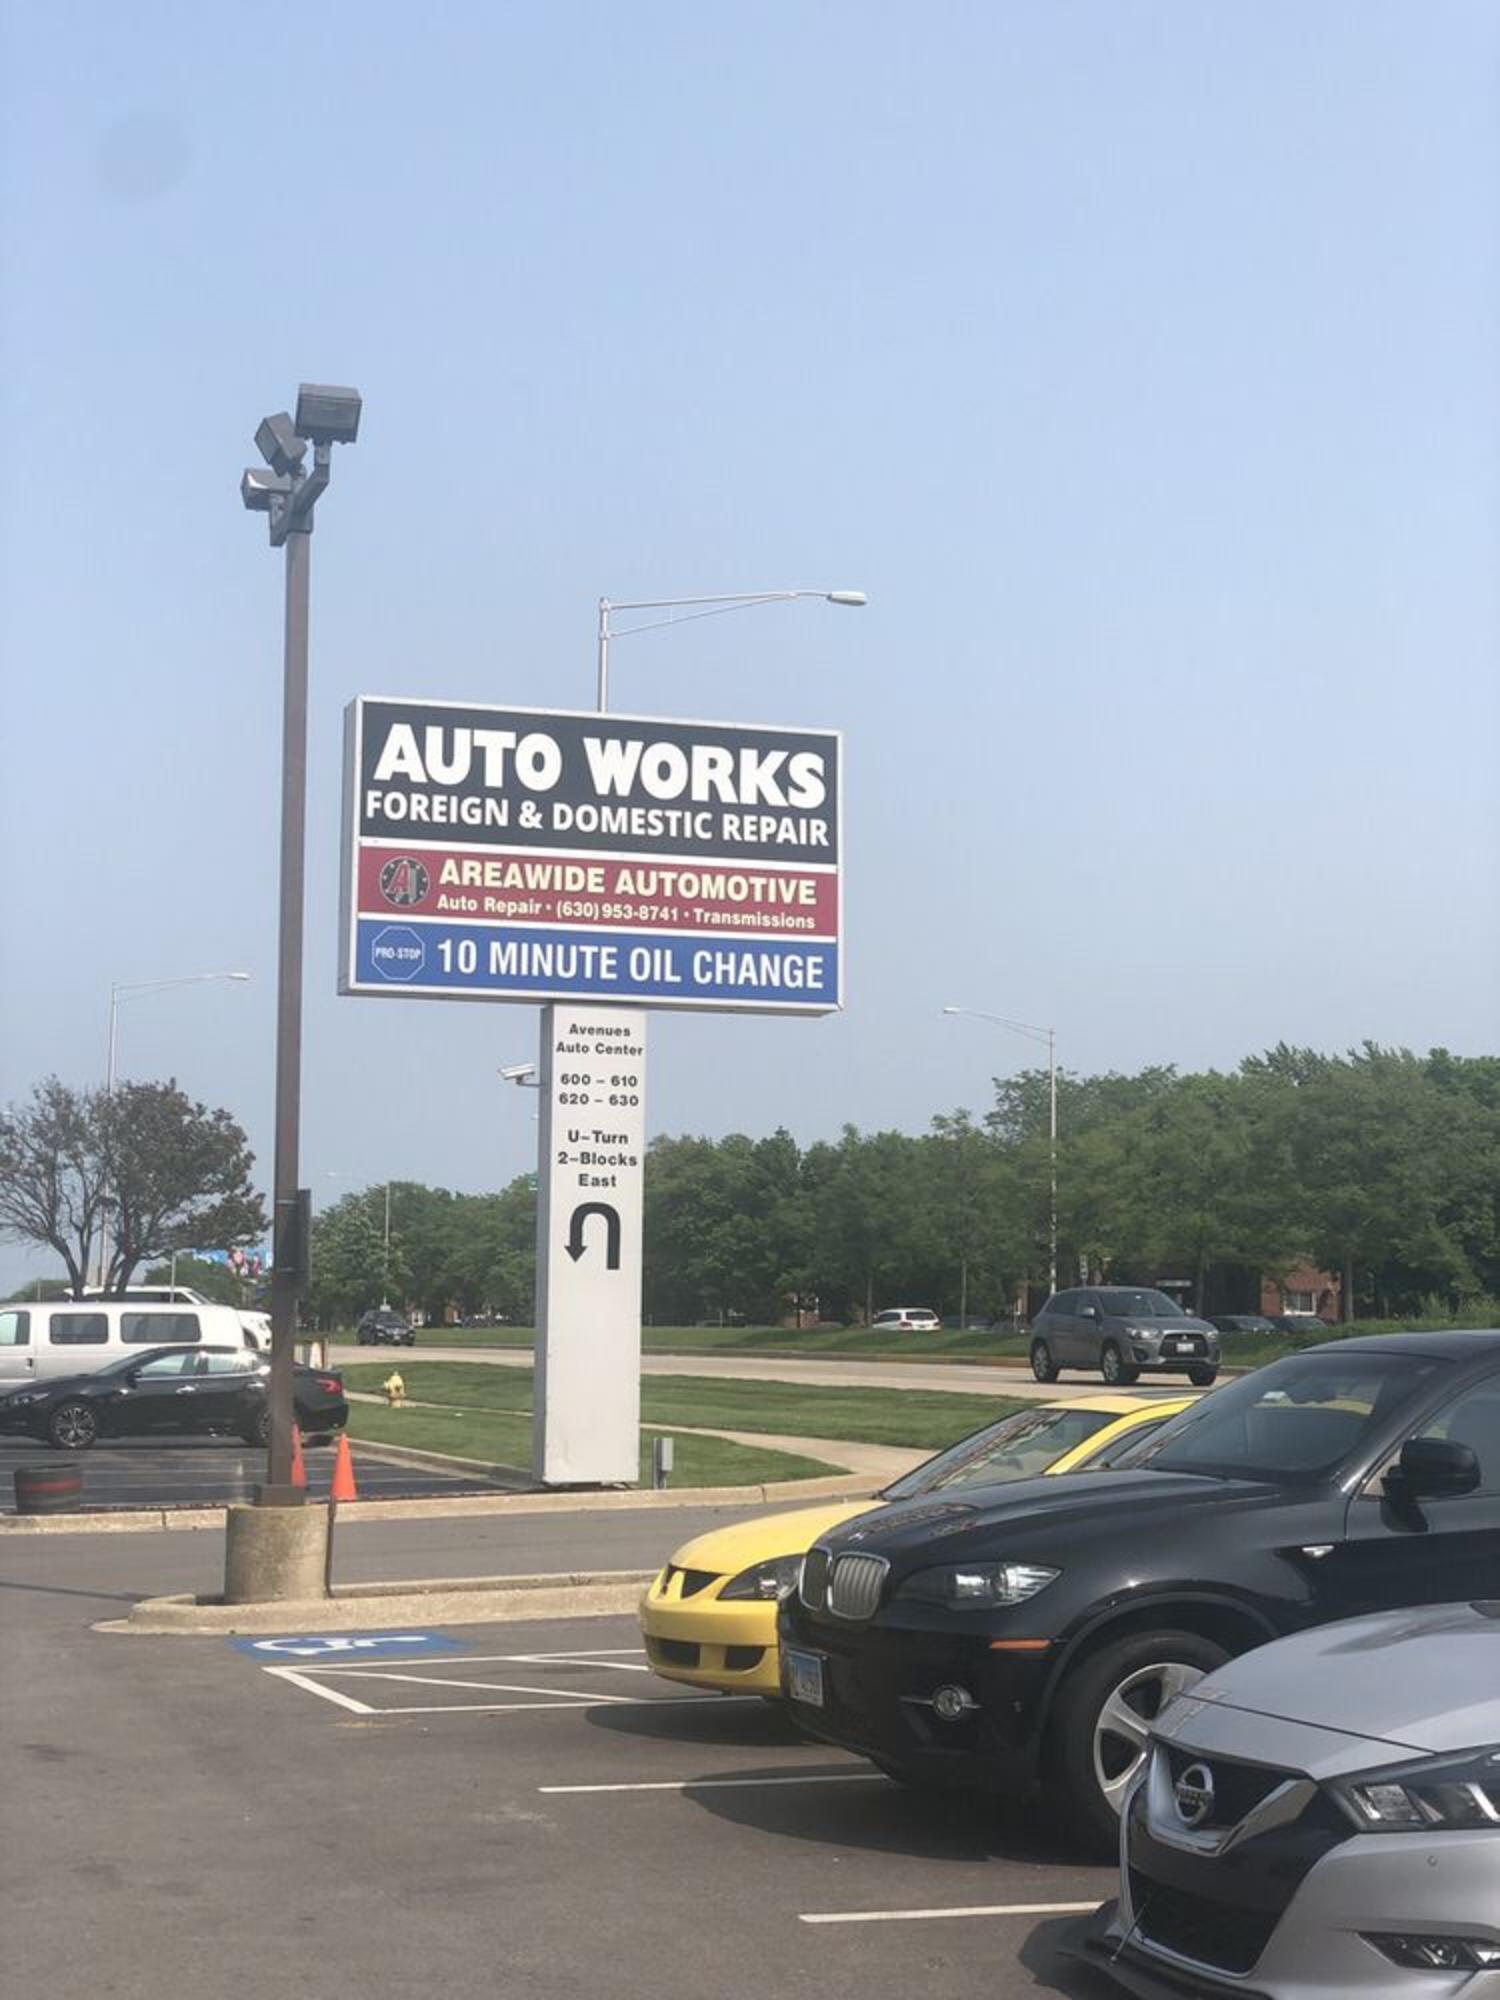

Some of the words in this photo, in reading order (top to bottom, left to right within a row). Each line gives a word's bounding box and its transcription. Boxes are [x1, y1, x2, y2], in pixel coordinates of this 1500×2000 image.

[373, 723, 562, 791] AUTO
[583, 737, 826, 809] WORKS
[366, 790, 509, 826] FOREIGN
[518, 800, 543, 829] &
[553, 803, 712, 838] DOMESTIC
[723, 813, 829, 847] REPAIR
[439, 859, 605, 893] AREAWIDE
[615, 869, 817, 905] AUTOMOTIVE
[437, 894, 478, 911] Auto
[484, 897, 542, 916] Repair
[556, 901, 599, 920] (630)
[602, 903, 678, 921] 953-8741
[693, 908, 816, 929] Transmissions
[375, 946, 421, 960] PRO-STOP
[437, 939, 477, 973] 10
[489, 941, 618, 979] MINUTE
[629, 947, 681, 982] OIL
[693, 950, 823, 989] CHANGE
[569, 1023, 631, 1037] Avenues
[556, 1041, 590, 1054] Auto
[595, 1042, 643, 1056] Center
[560, 1073, 591, 1085] 600
[610, 1075, 638, 1087] 610
[559, 1092, 590, 1105] 620
[608, 1094, 639, 1107] 630
[568, 1129, 629, 1144] U-Turn
[557, 1151, 638, 1167] 2-Blocks
[578, 1173, 617, 1187] East
